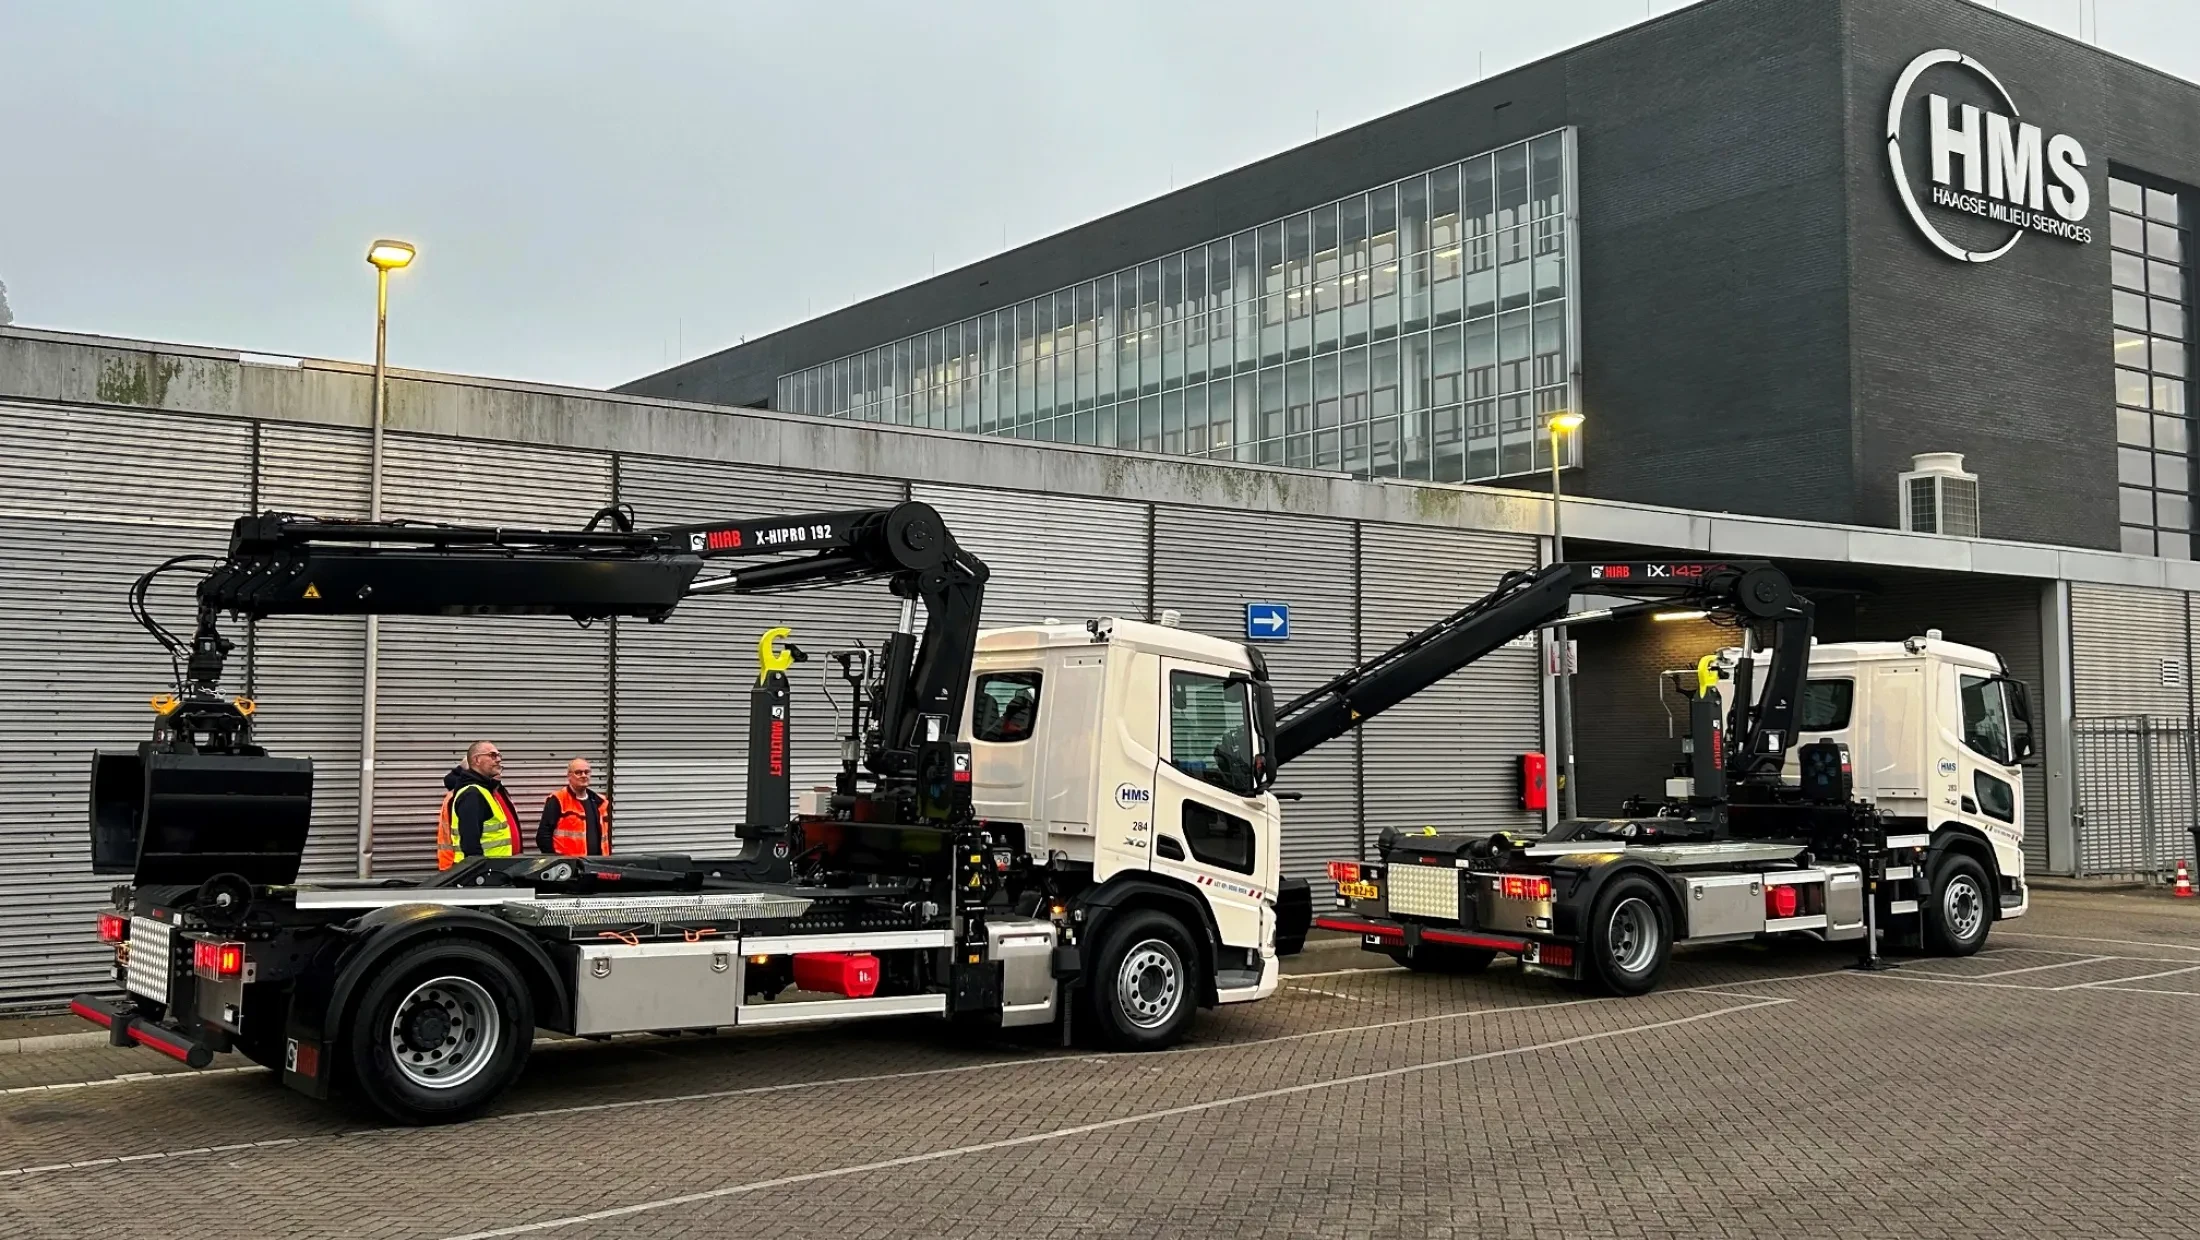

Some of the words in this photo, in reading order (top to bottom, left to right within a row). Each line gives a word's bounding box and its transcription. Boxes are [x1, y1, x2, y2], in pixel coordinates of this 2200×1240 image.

[1929, 93, 2090, 222] HMS
[1933, 187, 1987, 216] HAAGSE
[1989, 202, 2030, 228] MILIEU
[2032, 214, 2092, 244] SERVICES
[708, 530, 742, 549] HIAB
[755, 526, 806, 545] X-HIPRO
[810, 525, 832, 540] 192
[1605, 565, 1630, 578] HIAB
[769, 720, 784, 777] MULTILIFT
[1941, 762, 1956, 772] HMS
[1122, 788, 1150, 801] HMS
[1132, 821, 1148, 831] 284
